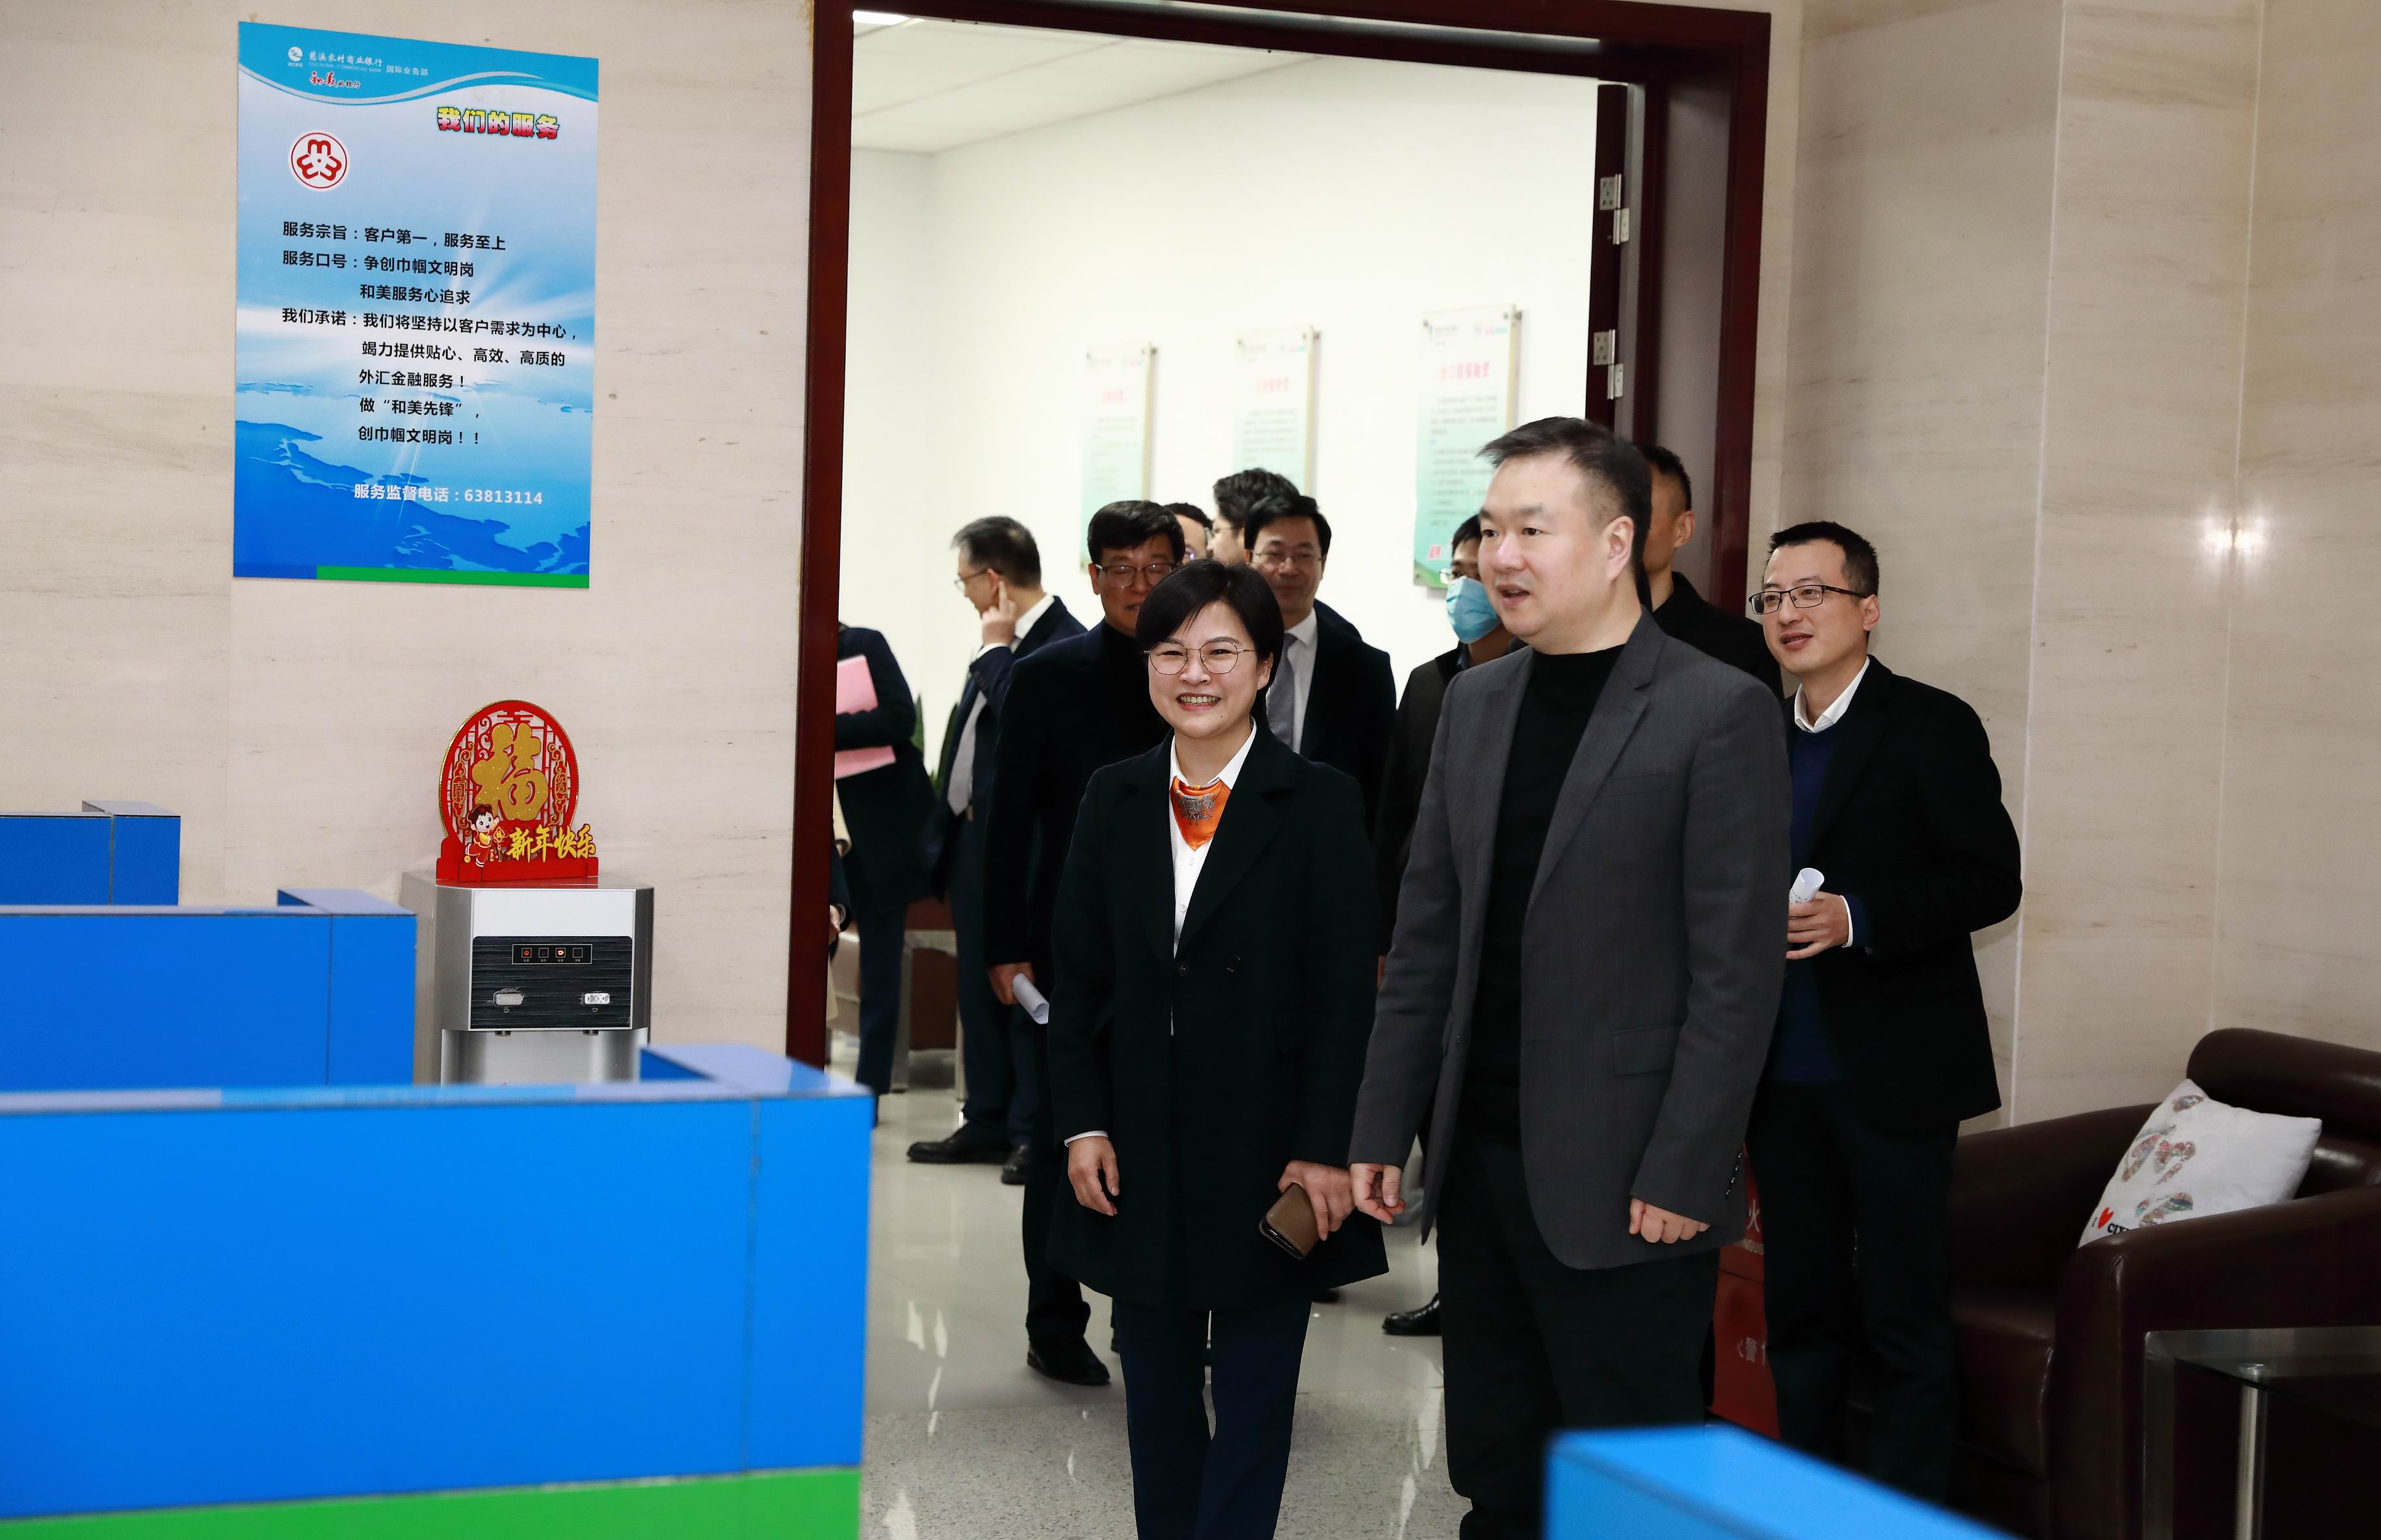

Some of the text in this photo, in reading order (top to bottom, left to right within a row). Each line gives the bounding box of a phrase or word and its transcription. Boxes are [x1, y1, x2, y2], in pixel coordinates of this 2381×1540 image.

[386, 65, 429, 76] 国际业务部
[437, 106, 560, 140] 我们的服务
[360, 284, 471, 305] 和美服务心追求
[359, 369, 465, 389] 外汇金融服务！
[354, 484, 544, 505] 服务监督电话：63813114
[471, 722, 549, 822] 福
[506, 824, 596, 863] 新年快乐
